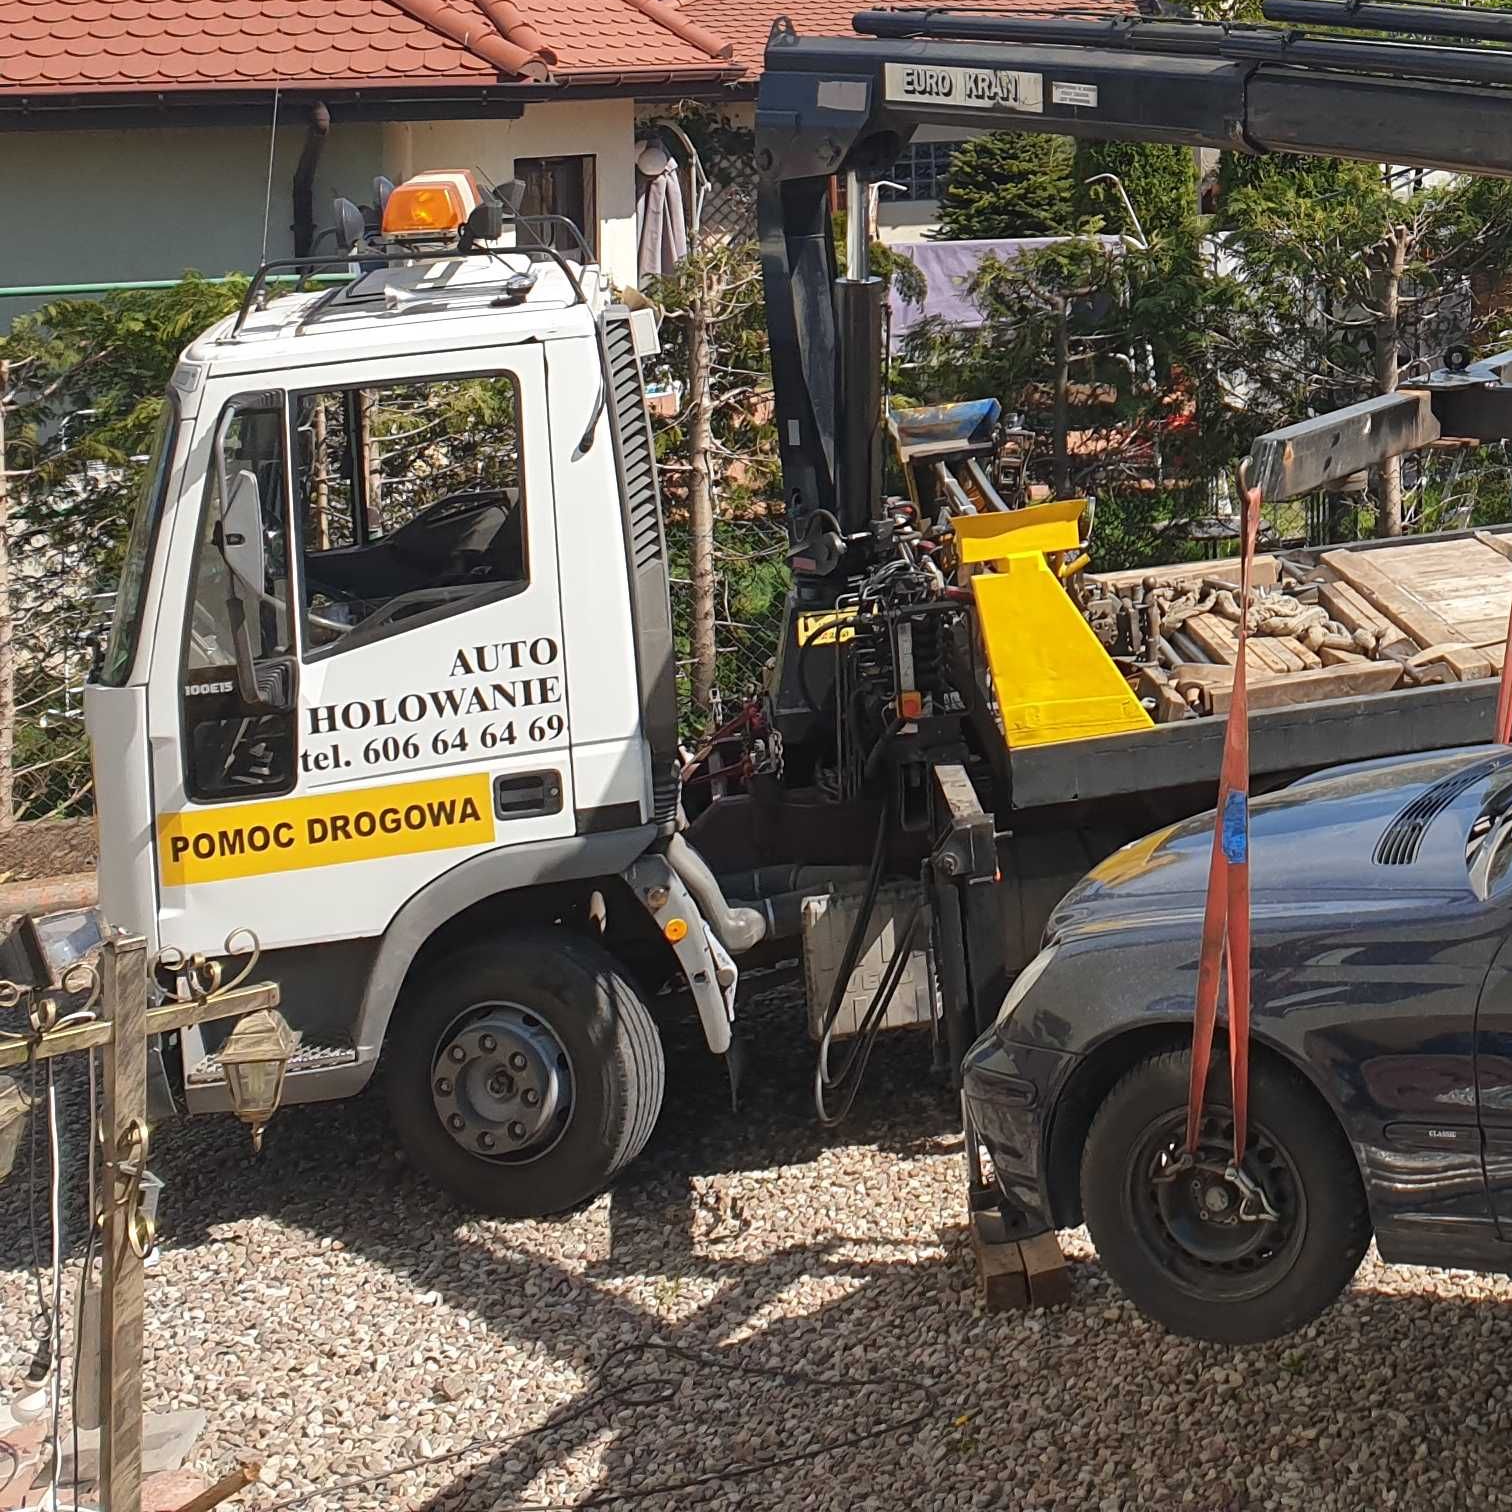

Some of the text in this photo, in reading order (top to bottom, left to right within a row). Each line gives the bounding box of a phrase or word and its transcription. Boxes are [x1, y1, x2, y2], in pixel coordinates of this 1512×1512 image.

[903, 67, 953, 97] EURO
[964, 70, 1021, 103] KRAN
[449, 637, 558, 677] AUTO
[307, 676, 562, 735] HOLOWANIE
[300, 714, 564, 773] tel. 606 64 64 69
[171, 797, 481, 863] POMOC DROGOWA
